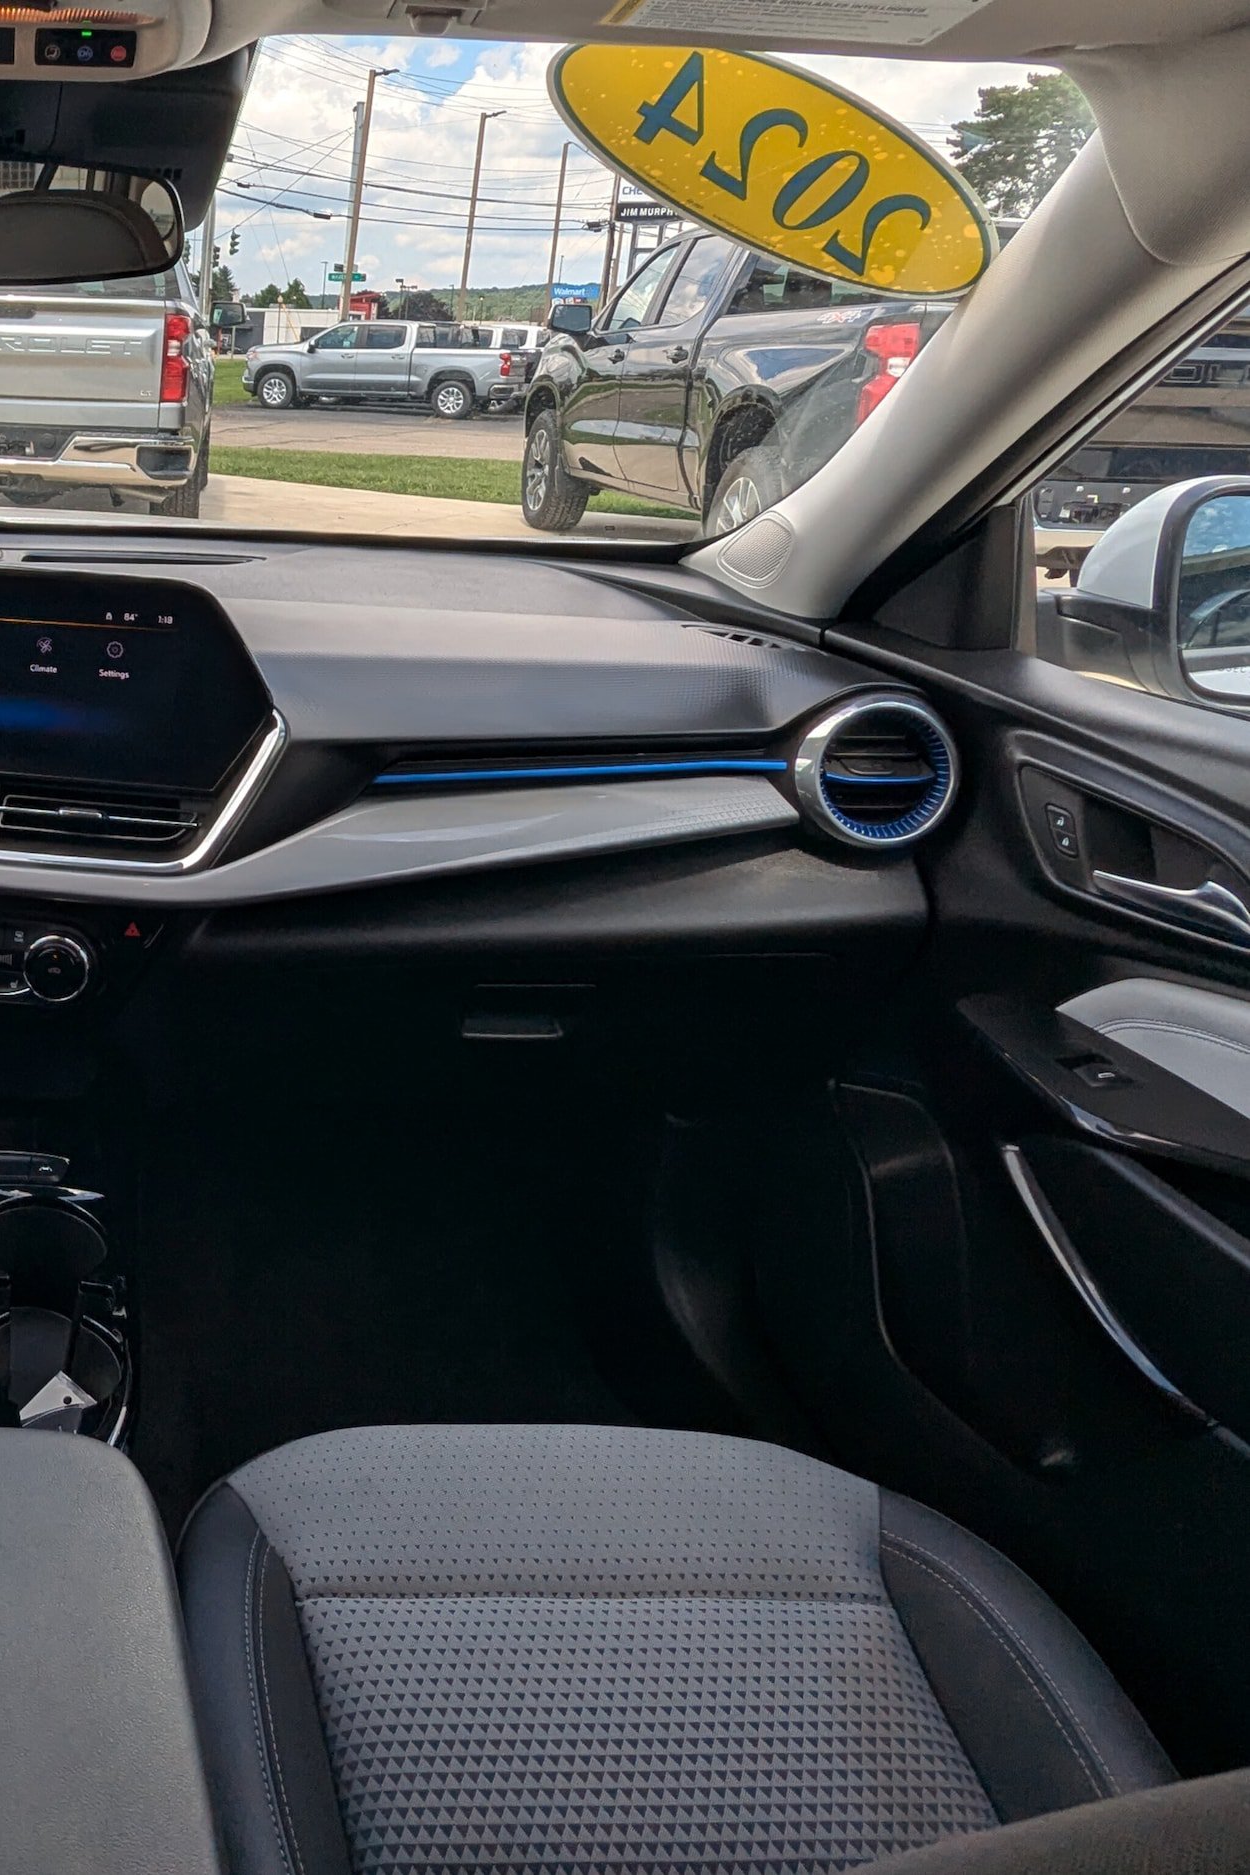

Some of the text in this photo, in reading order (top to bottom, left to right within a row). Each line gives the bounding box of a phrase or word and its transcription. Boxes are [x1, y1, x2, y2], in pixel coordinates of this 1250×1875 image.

[620, 207, 679, 217] JIM MURPH
[553, 287, 586, 296] Walmart
[29, 664, 58, 674] Climate
[98, 668, 130, 681] Settings
